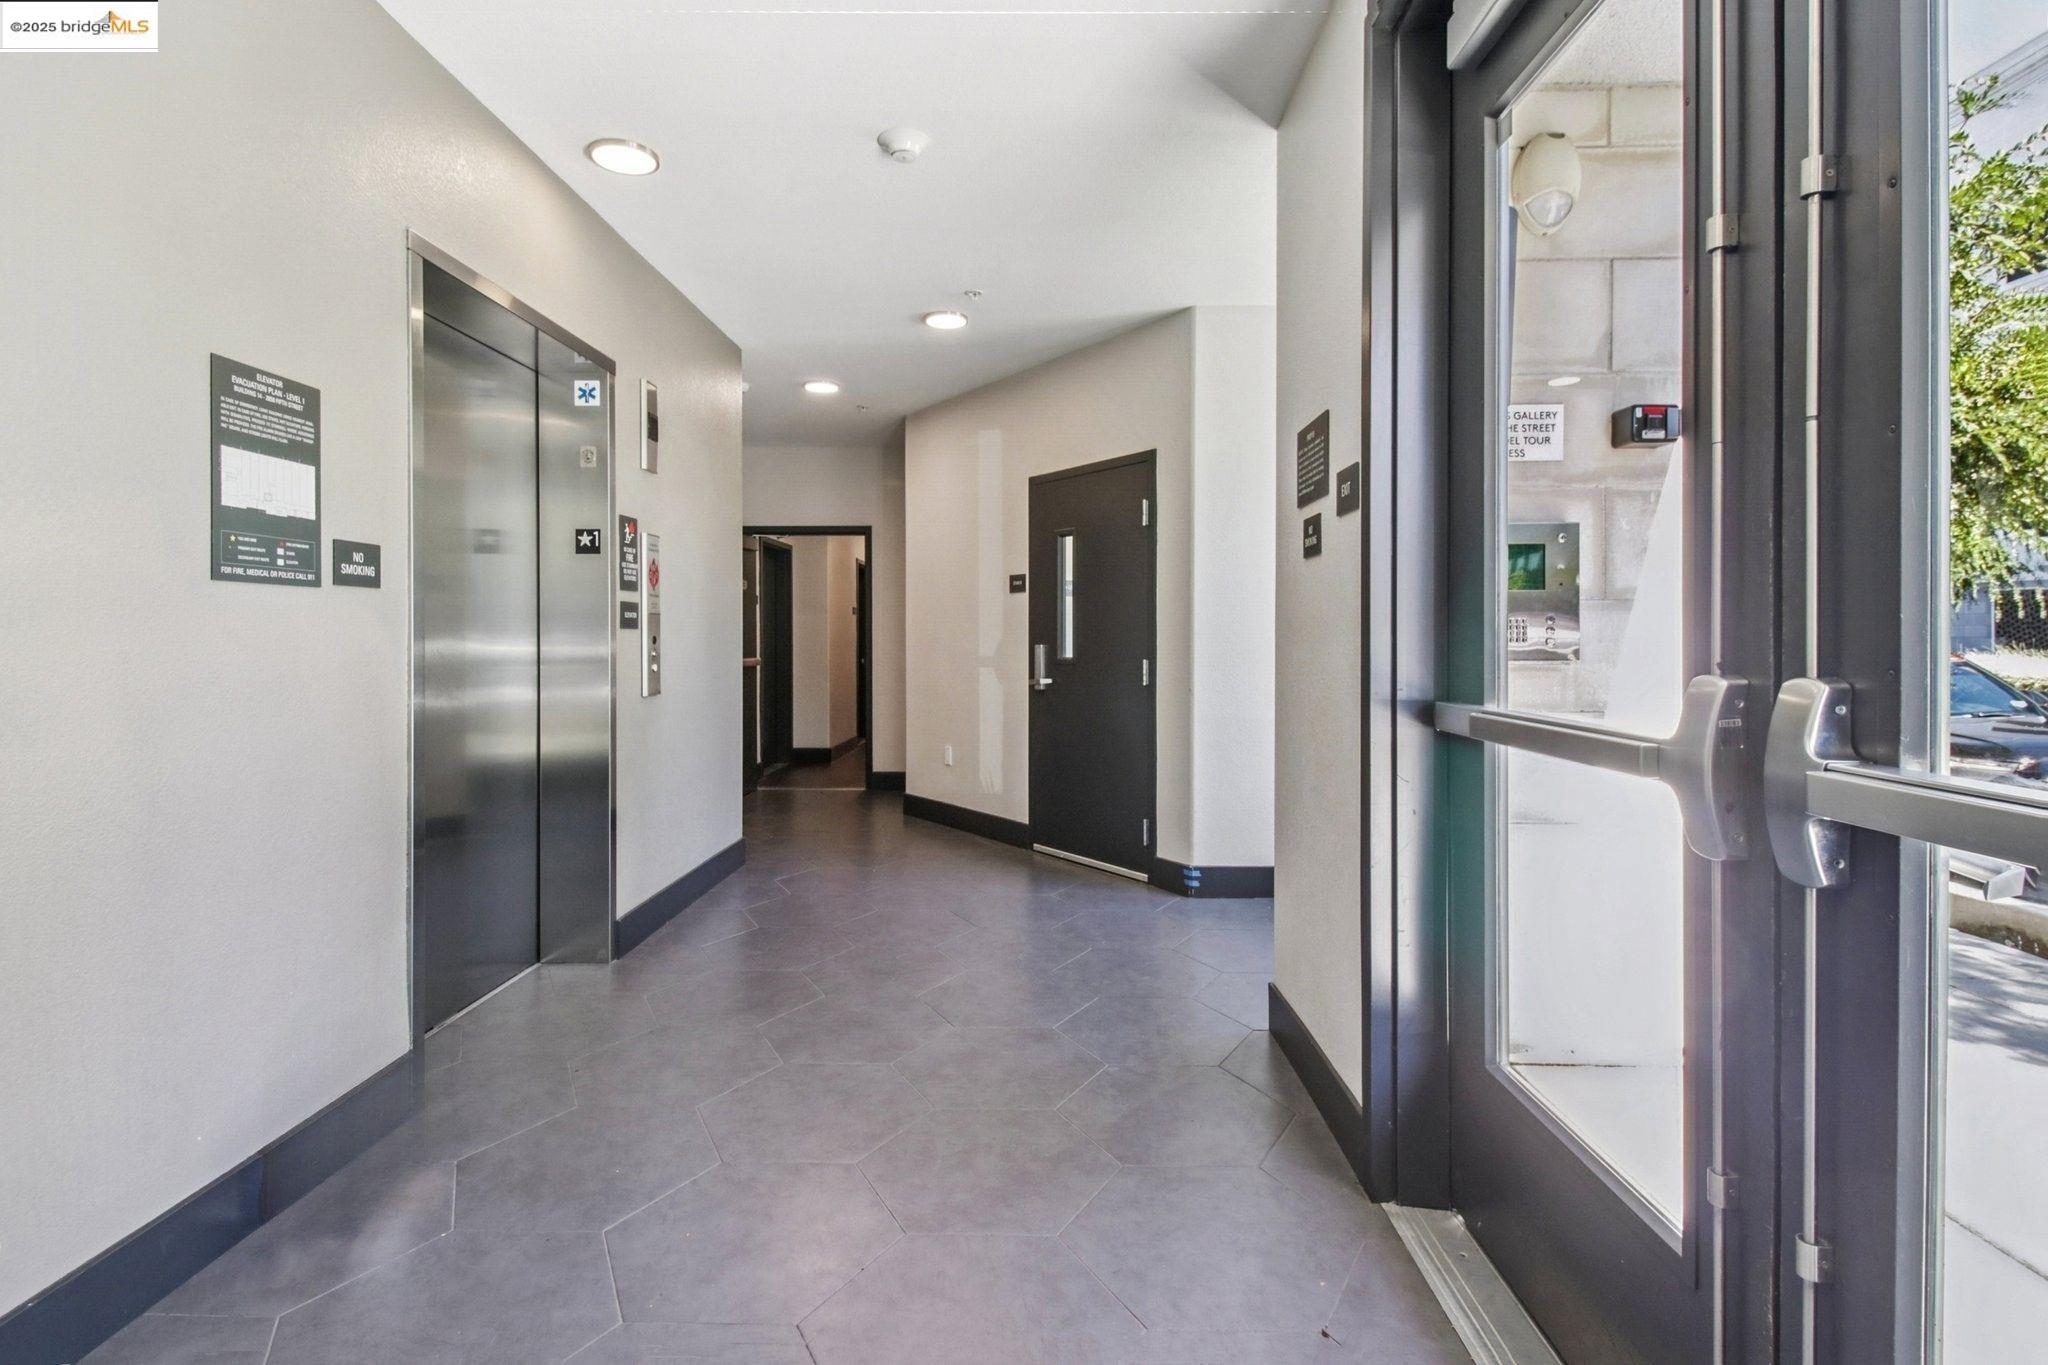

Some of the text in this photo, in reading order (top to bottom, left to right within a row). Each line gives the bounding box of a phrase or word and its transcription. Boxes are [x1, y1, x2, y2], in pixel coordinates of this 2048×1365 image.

[256, 373, 284, 389] ELEVATOR
[231, 374, 268, 393] EVACUATION
[268, 386, 283, 398] PLAN
[286, 392, 302, 404] LEVEL
[1513, 411, 1558, 421] GALLERY
[1521, 423, 1556, 433] STREET
[1523, 436, 1552, 445] TOUR
[1341, 481, 1351, 498] EXIT
[593, 531, 600, 547] 1
[352, 551, 365, 564] NO
[220, 566, 232, 575] FOR
[246, 568, 270, 578] MEDICAL
[270, 570, 278, 578] OR
[278, 570, 295, 580] POLICE
[295, 572, 308, 580] CALL
[340, 563, 376, 577] SMOKING
